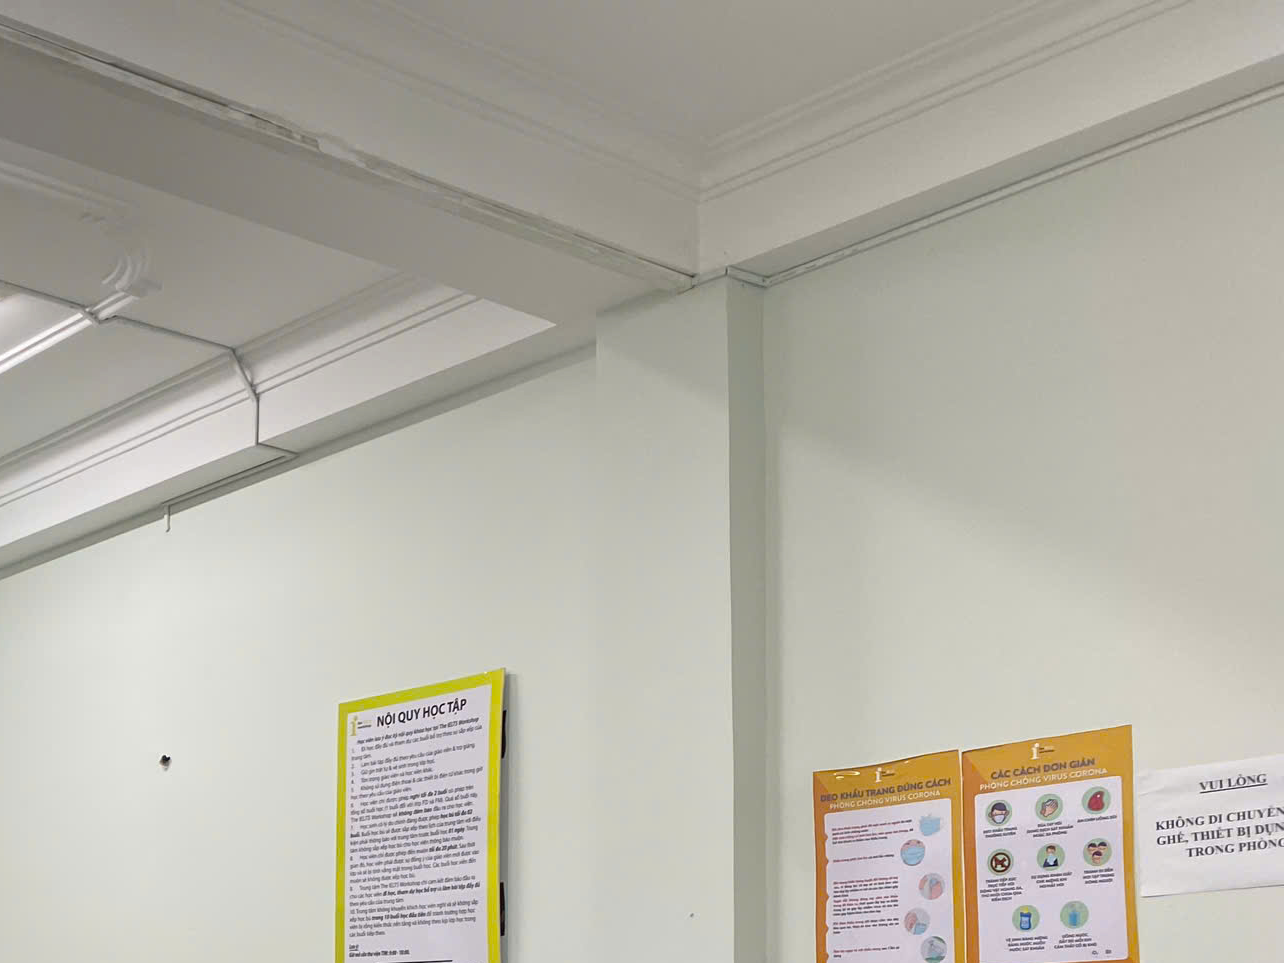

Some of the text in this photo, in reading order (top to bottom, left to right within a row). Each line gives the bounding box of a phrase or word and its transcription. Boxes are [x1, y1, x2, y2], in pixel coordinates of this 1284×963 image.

[377, 712, 395, 728] NỘI
[398, 709, 420, 723] QUY
[423, 703, 445, 719] HỌC
[447, 698, 467, 715] TẬP
[1044, 773, 1068, 781] VIRUS
[1069, 768, 1108, 778] CORONA
[1199, 773, 1267, 790] VUI LÒNG
[866, 787, 895, 796] TRANG
[885, 794, 906, 802] VIRUS
[907, 790, 941, 800] CORONA
[1156, 816, 1205, 830] KHÔNG
[1208, 813, 1222, 824] DI
[1156, 831, 1189, 845] GHẾ,
[1191, 827, 1233, 842] THIẾT
[1237, 826, 1251, 838] BỊ
[1186, 837, 1284, 857] TRONG PHÒNG
